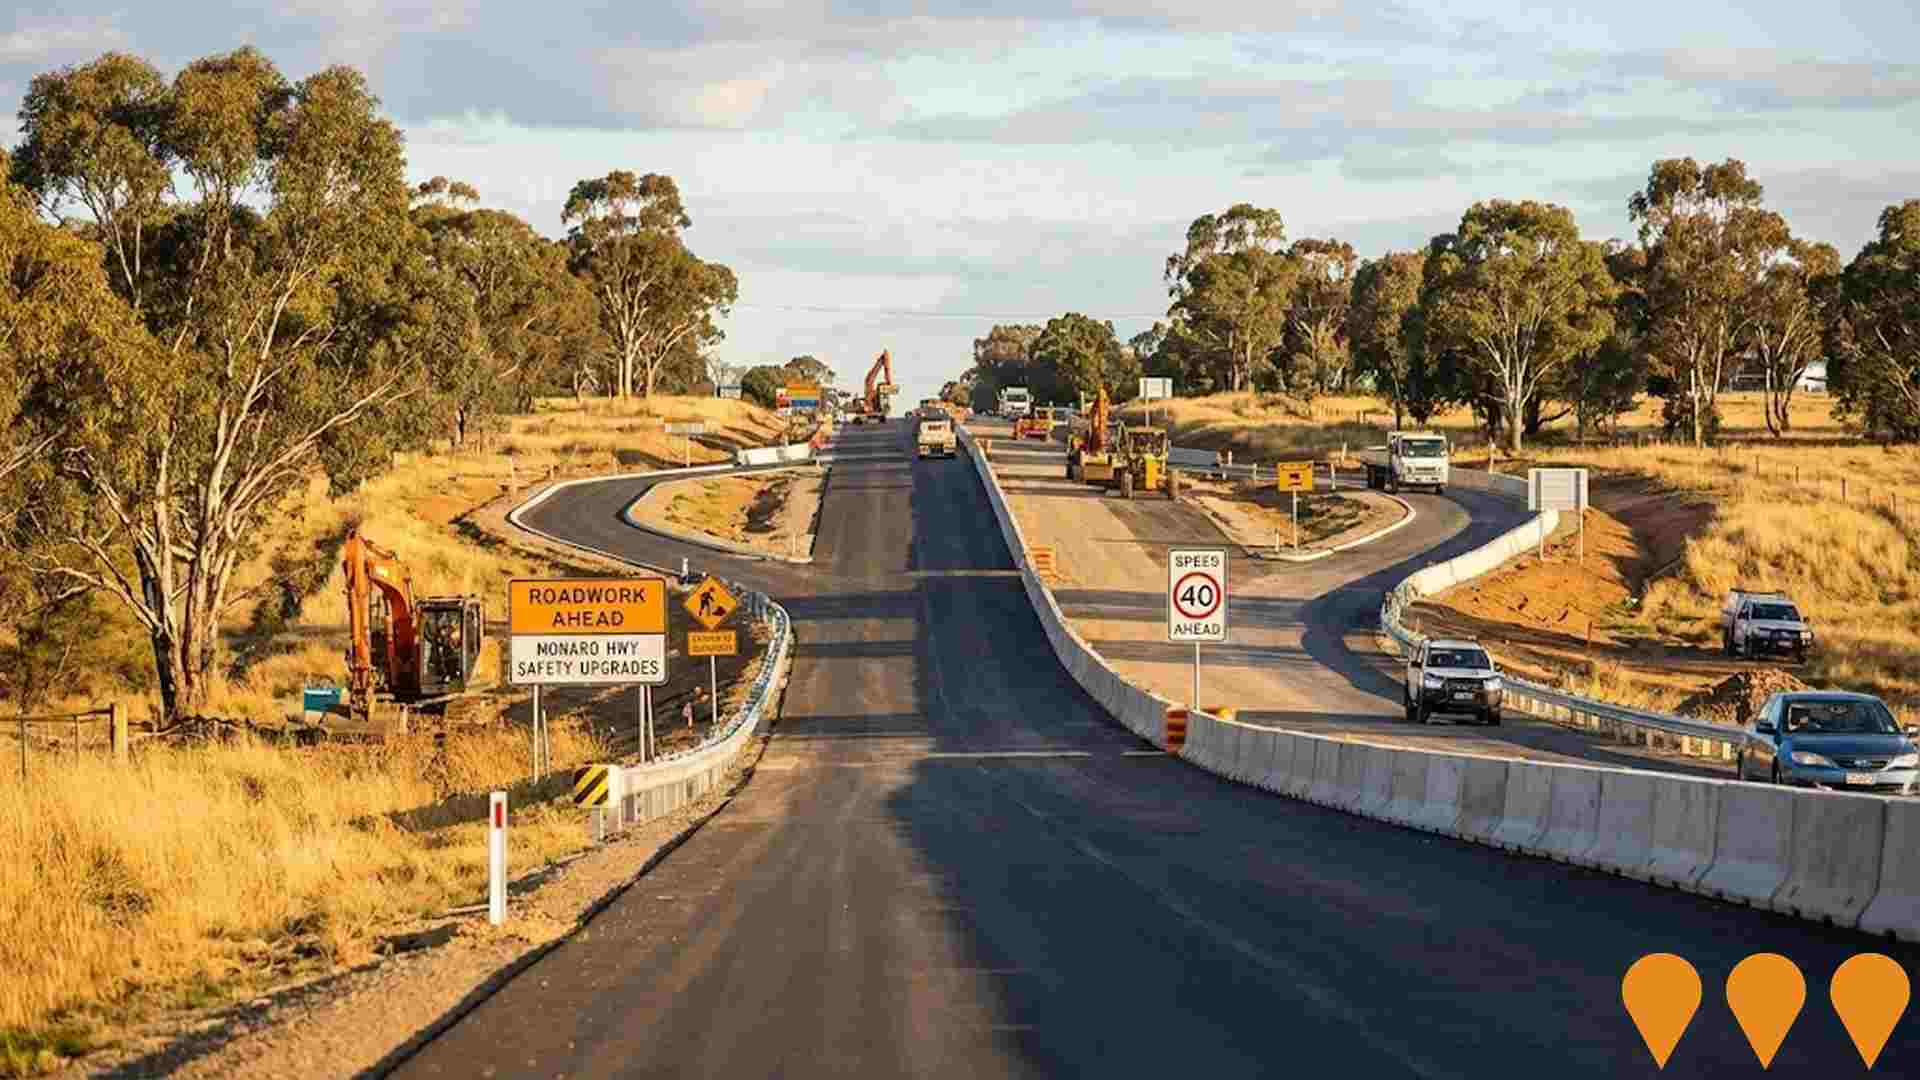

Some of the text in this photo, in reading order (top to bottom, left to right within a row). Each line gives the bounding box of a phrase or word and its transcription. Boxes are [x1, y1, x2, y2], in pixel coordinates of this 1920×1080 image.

[529, 588, 646, 604] ROADWORK
[1180, 585, 1213, 606] 40
[552, 611, 624, 627] AHEAD
[1174, 624, 1220, 635] AHEAD
[537, 641, 639, 656] MONARO HWY
[518, 660, 659, 676] SAFETY UPGRADES
